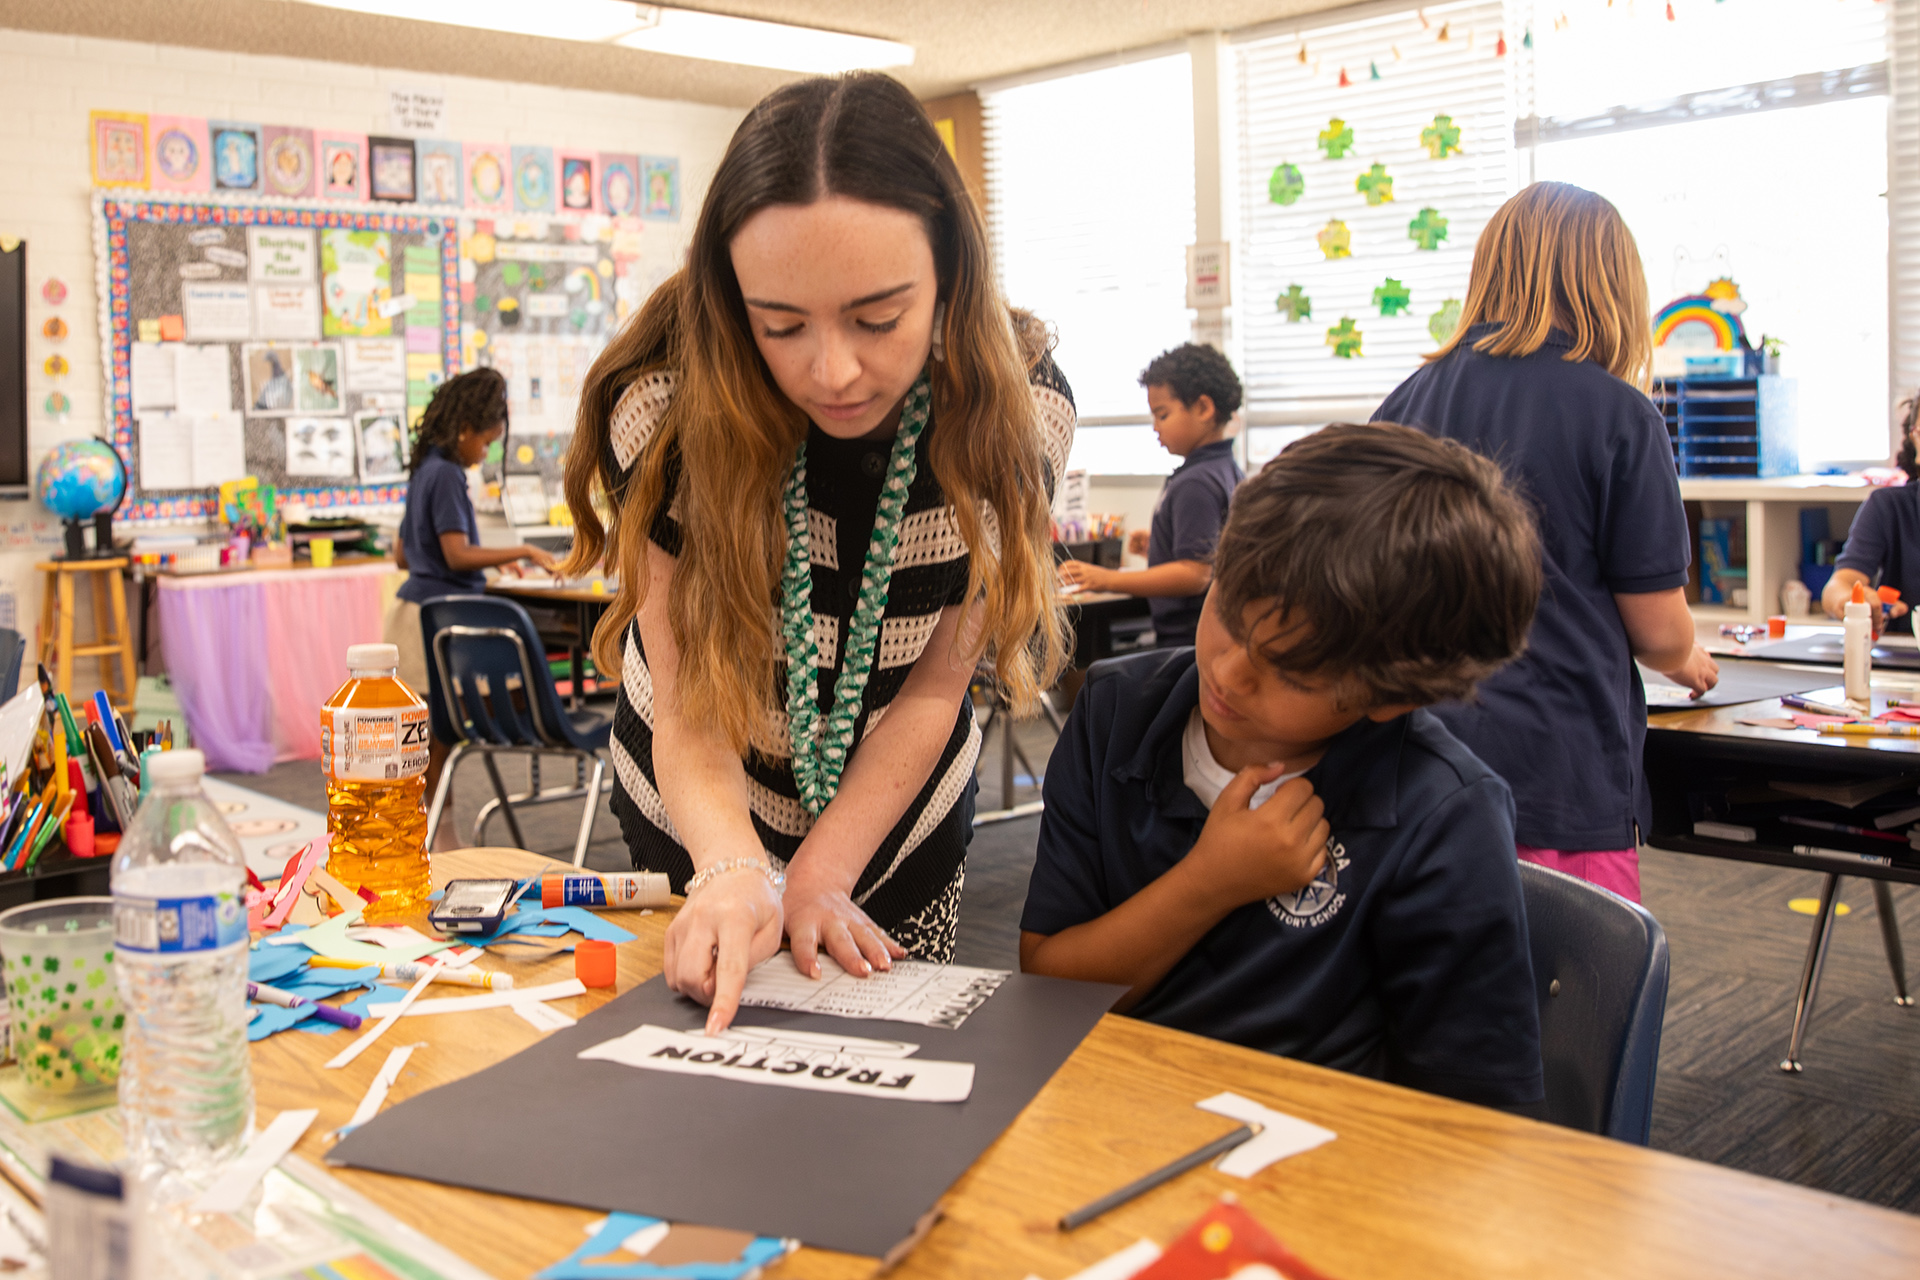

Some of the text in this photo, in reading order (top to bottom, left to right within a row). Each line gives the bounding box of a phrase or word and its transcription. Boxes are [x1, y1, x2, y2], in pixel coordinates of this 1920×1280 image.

[1326, 835, 1351, 872] ADA
[1309, 893, 1347, 928] SCHOOL
[650, 1046, 915, 1090] FRACTION
